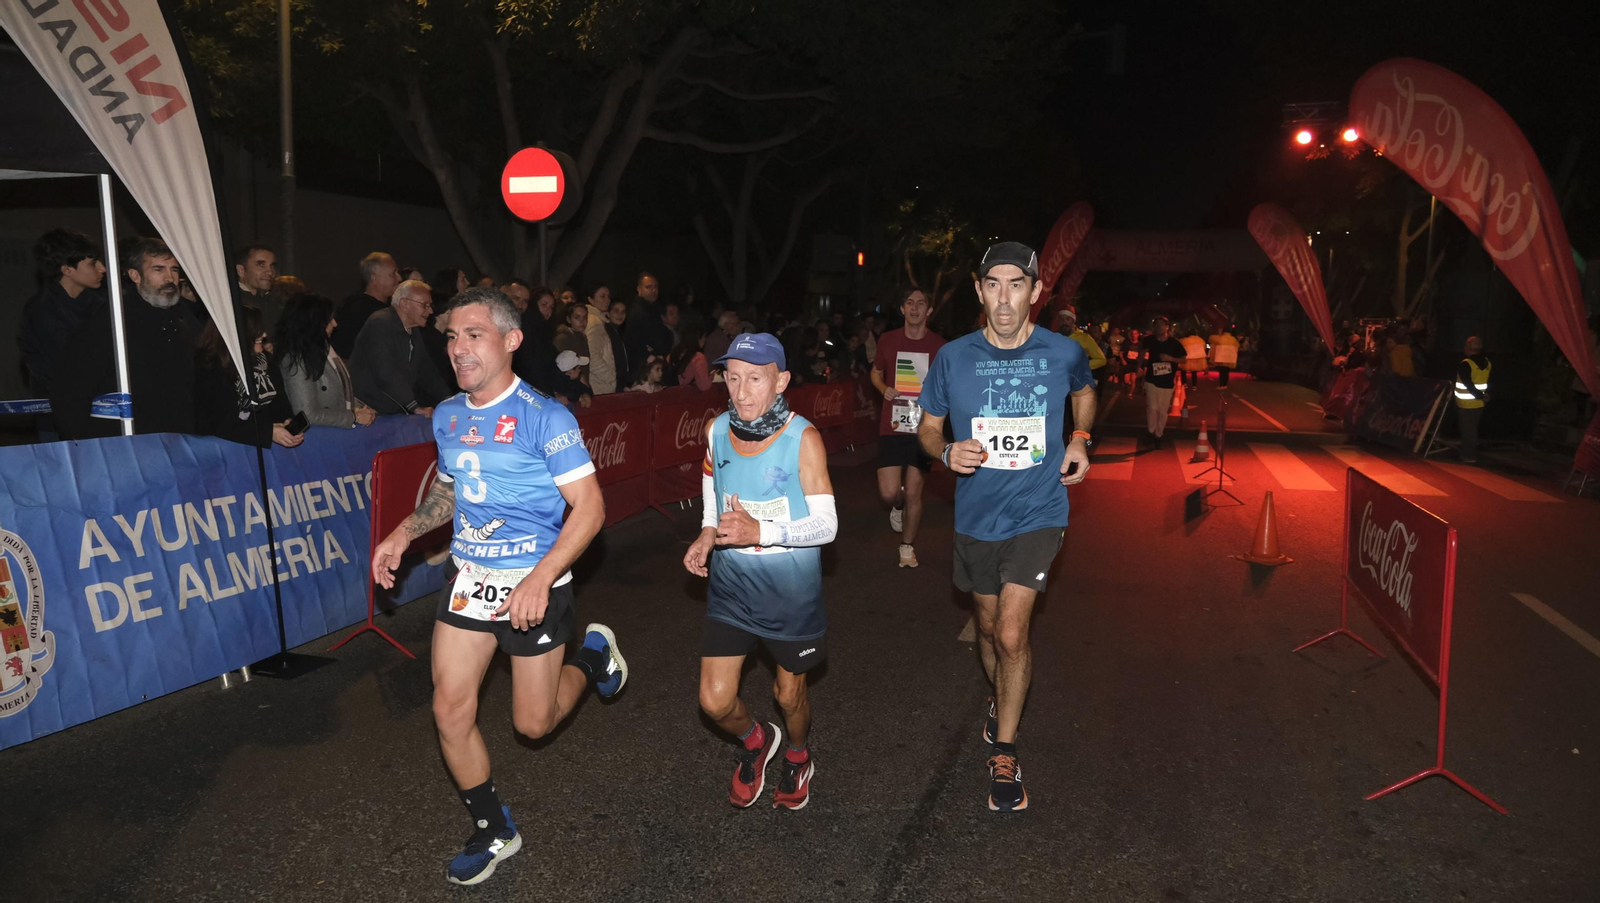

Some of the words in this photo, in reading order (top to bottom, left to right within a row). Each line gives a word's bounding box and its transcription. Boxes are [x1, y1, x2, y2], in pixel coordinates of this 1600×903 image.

[1000, 359, 1034, 367] SILVESTRE
[493, 435, 513, 443] SM-2
[989, 435, 1029, 451] 162
[456, 451, 487, 504] 3
[453, 540, 537, 557] MICHELIN
[1359, 501, 1419, 612] Coca-Cola
[23, 555, 35, 573] POR
[31, 577, 38, 591] LA
[84, 571, 163, 633] DE
[178, 525, 350, 610] ALMERÍA
[30, 594, 40, 639] LIBERTAD
[798, 647, 816, 658] adidas
